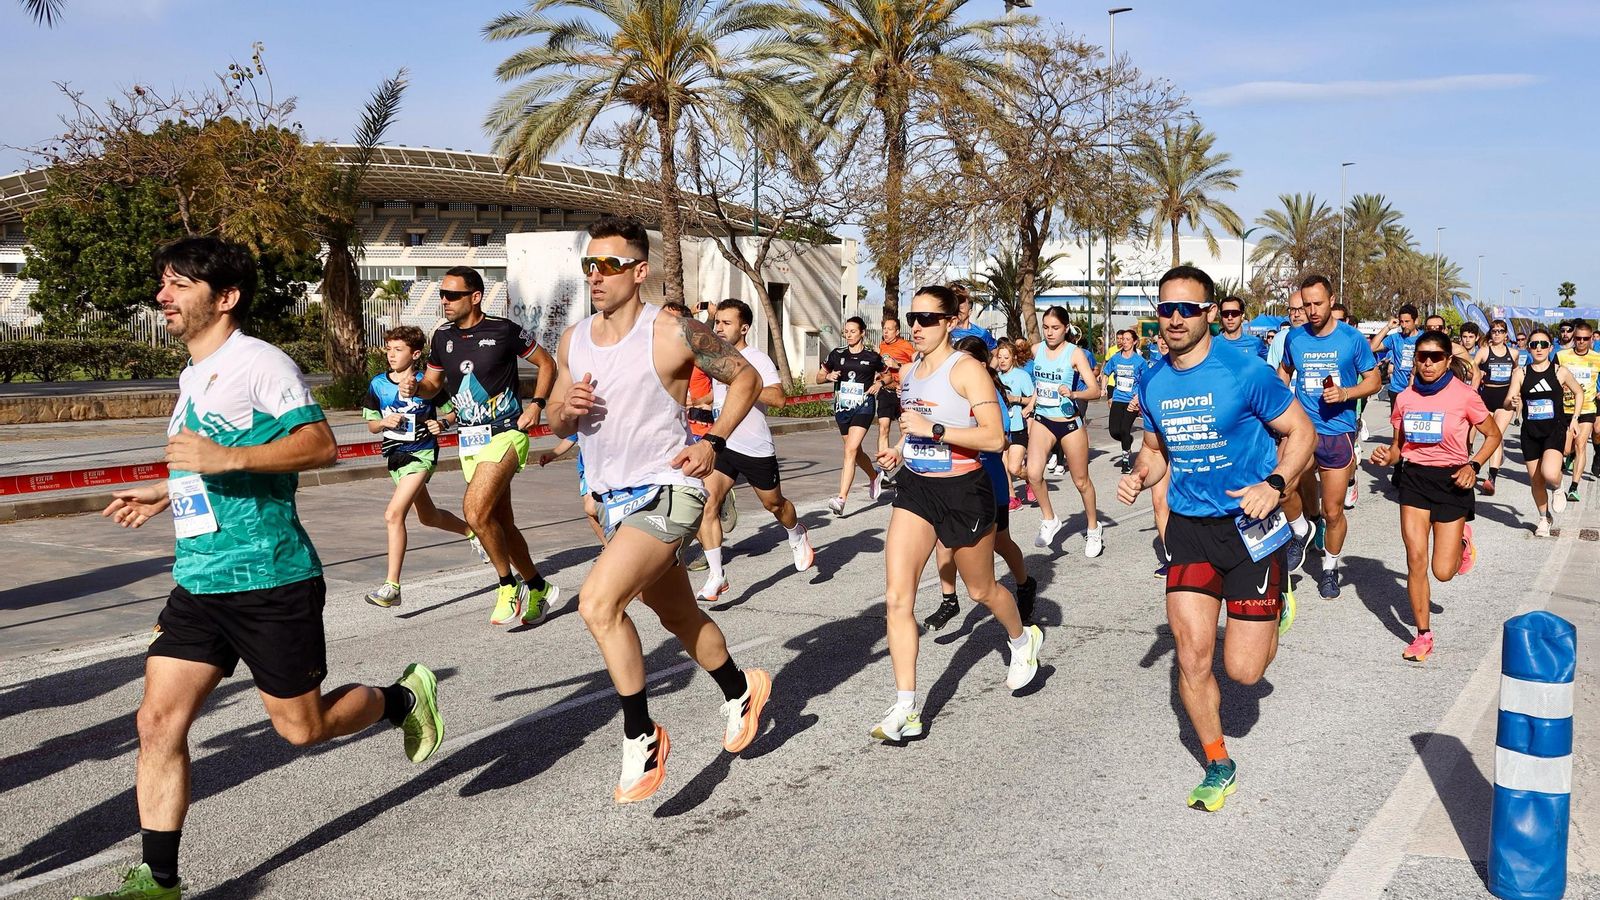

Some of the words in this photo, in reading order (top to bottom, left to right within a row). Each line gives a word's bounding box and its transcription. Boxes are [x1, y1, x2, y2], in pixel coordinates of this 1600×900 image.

[1303, 350, 1338, 360] mayoral
[1034, 369, 1062, 381] nerja
[1161, 393, 1213, 410] mayoral
[1413, 421, 1431, 431] 508
[464, 435, 486, 446] 1233
